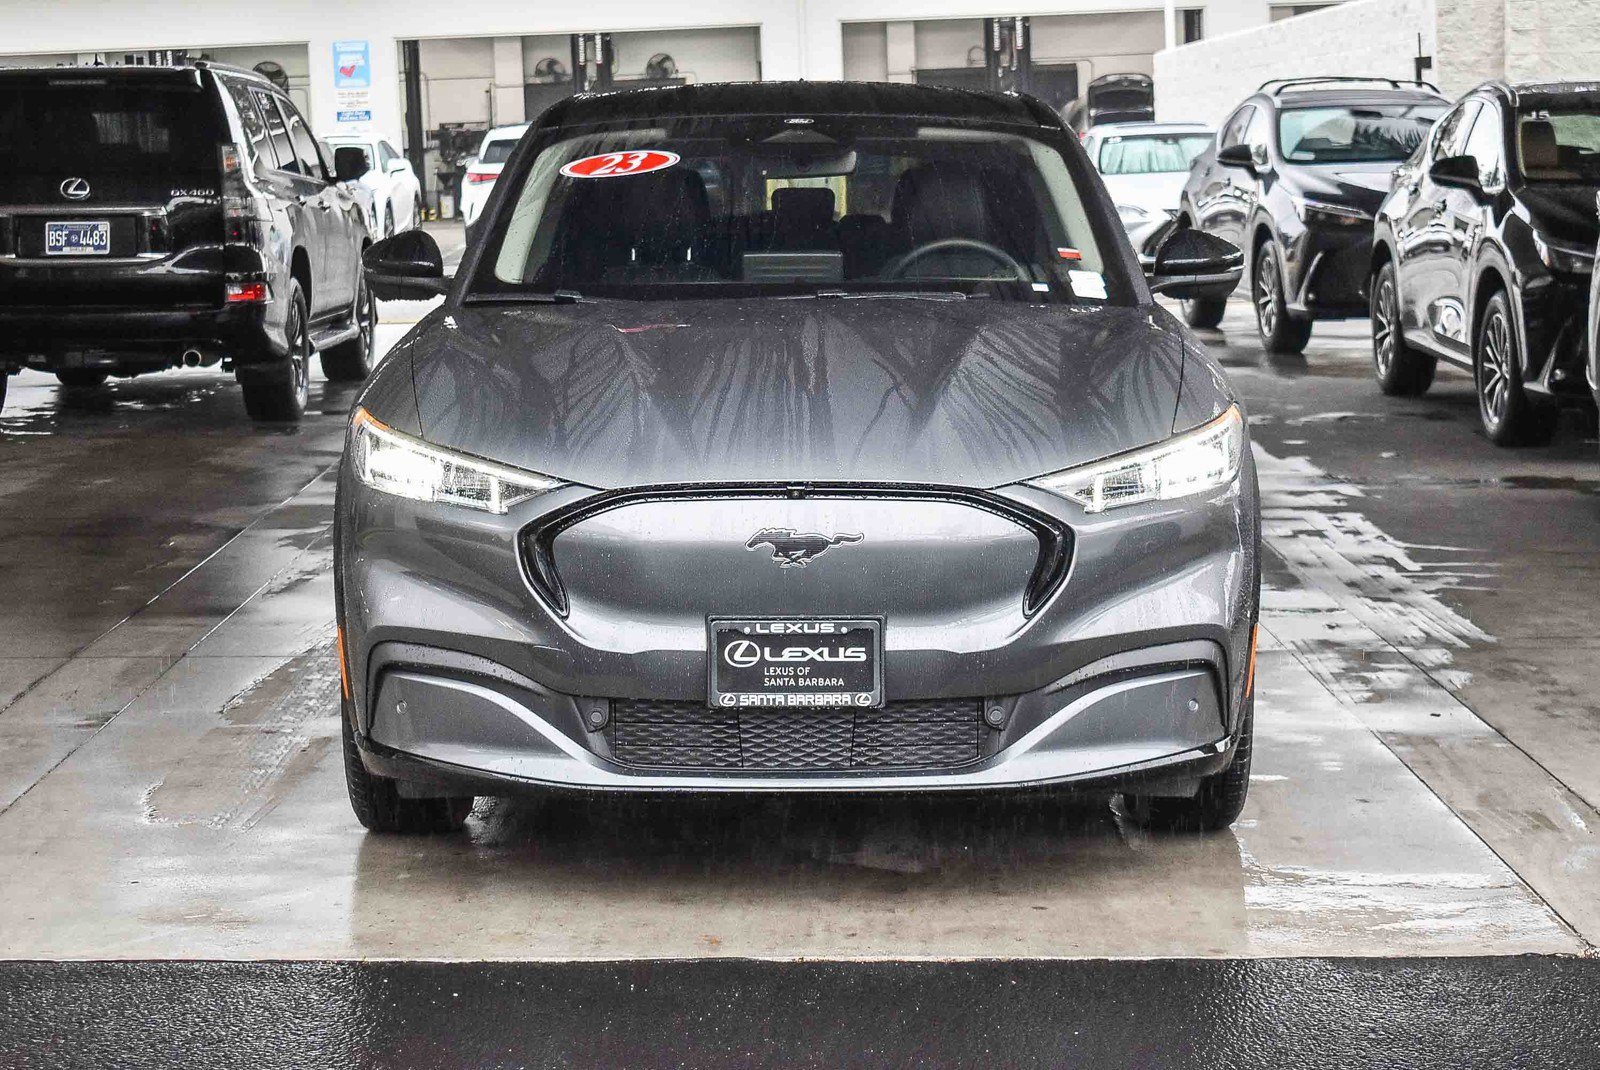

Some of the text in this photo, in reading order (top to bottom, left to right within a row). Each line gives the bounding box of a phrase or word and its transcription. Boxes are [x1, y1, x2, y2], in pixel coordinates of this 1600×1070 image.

[589, 152, 649, 175] 23
[49, 230, 107, 247] BSF 4483
[755, 623, 835, 634] LEXUS
[763, 647, 867, 662] LEXUS
[764, 666, 811, 676] LEXUS OF
[763, 677, 845, 687] SANTA BARBARA
[739, 693, 851, 706] SANTA BARBARA
